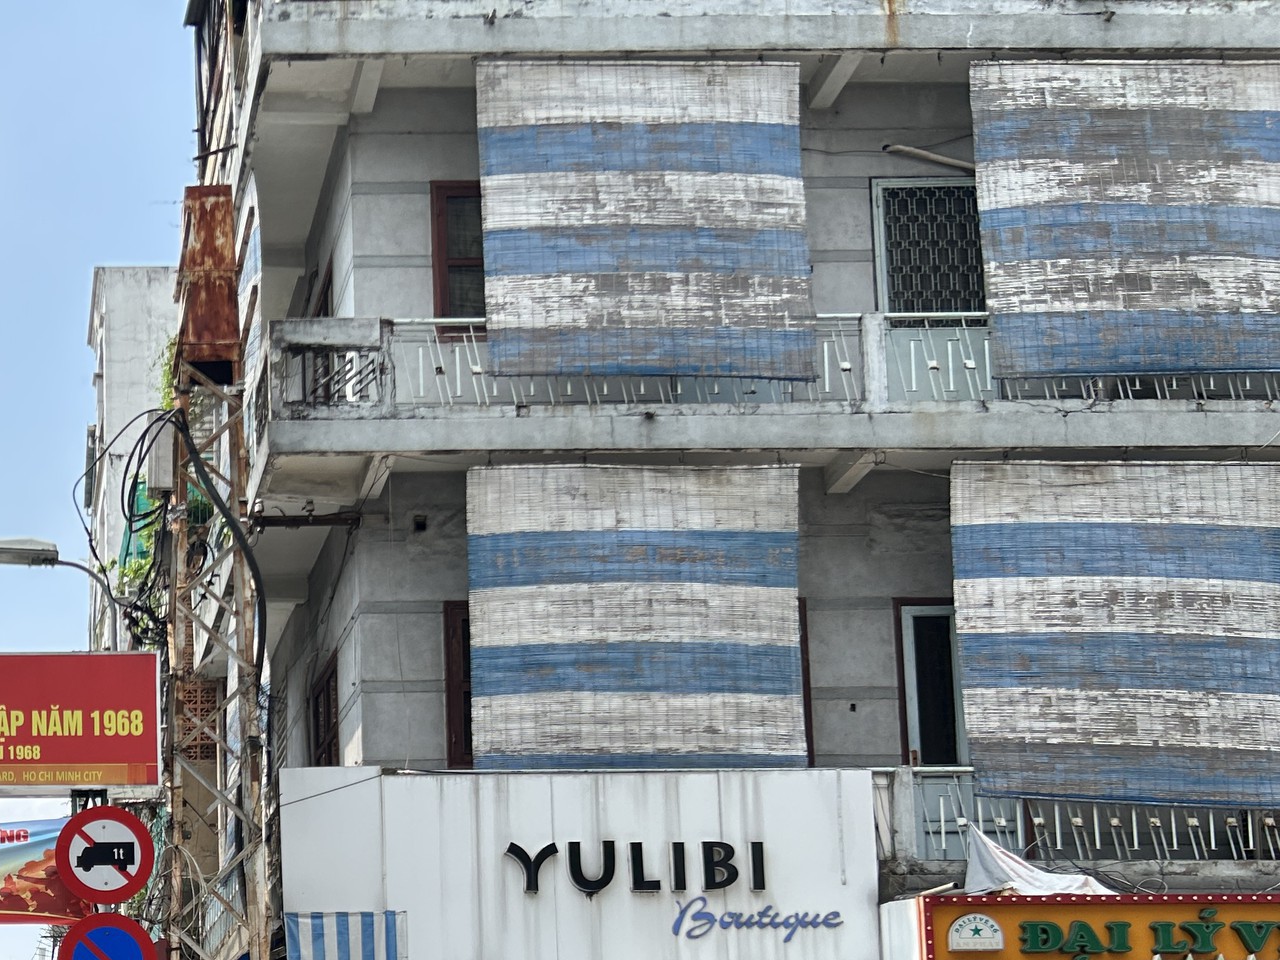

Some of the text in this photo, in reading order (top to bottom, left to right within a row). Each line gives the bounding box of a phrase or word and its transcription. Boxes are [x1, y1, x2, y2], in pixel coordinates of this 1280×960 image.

[32, 705, 82, 736] NĂM
[91, 710, 143, 736] 1968
[8, 745, 40, 759] 1968
[112, 848, 124, 860] 1t
[505, 839, 767, 894] YULIBI
[672, 896, 844, 942] Boutique
[1149, 908, 1225, 955] LÝ
[1230, 920, 1280, 955] V
